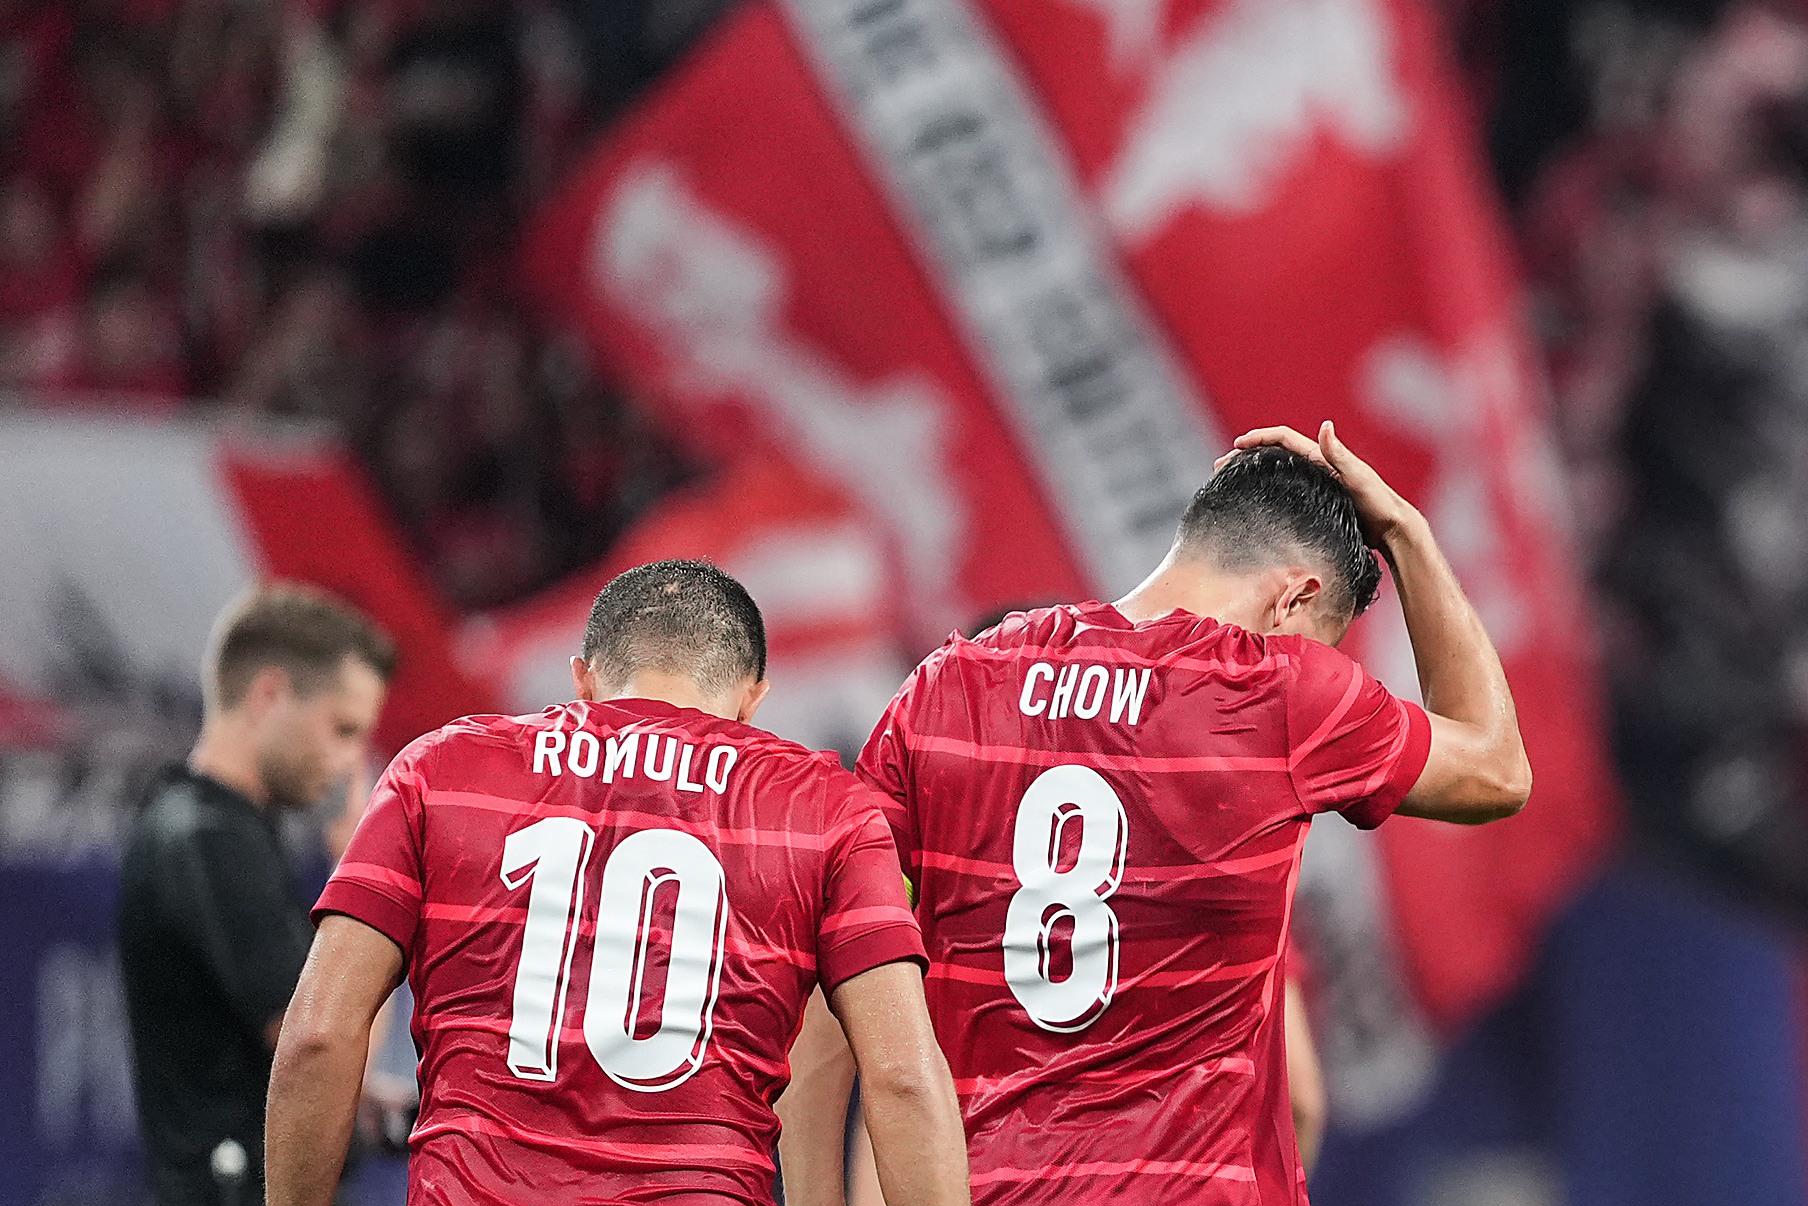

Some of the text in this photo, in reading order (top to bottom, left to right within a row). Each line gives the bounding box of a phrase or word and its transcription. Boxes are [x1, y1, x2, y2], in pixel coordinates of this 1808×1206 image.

[532, 730, 738, 795] ROMULO
[1019, 662, 1152, 726] CHOW
[500, 816, 729, 1093] 10
[1002, 763, 1129, 1034] 8
